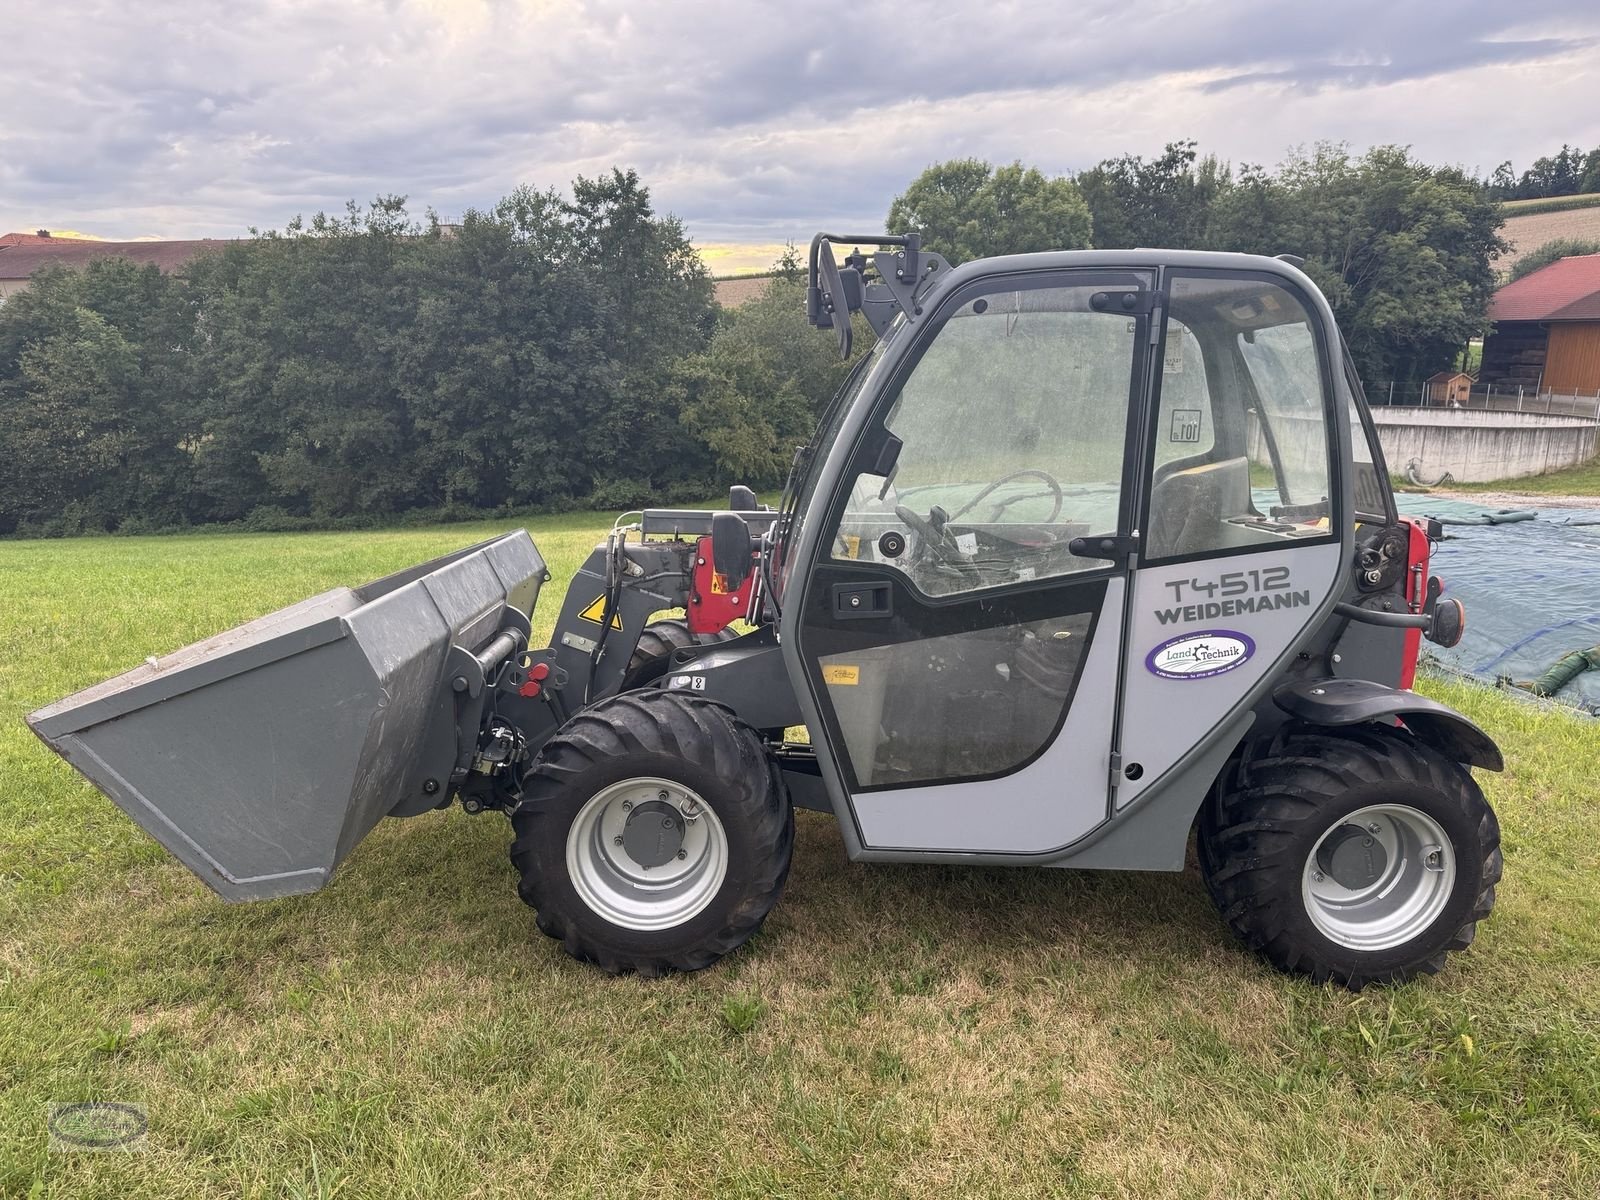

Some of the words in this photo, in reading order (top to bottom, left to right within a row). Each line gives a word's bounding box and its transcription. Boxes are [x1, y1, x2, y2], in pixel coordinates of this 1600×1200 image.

[1165, 566, 1291, 603] T4512
[1154, 590, 1310, 625] WEIDEMANN
[1166, 647, 1192, 661] Land
[1200, 646, 1240, 660] Technik
